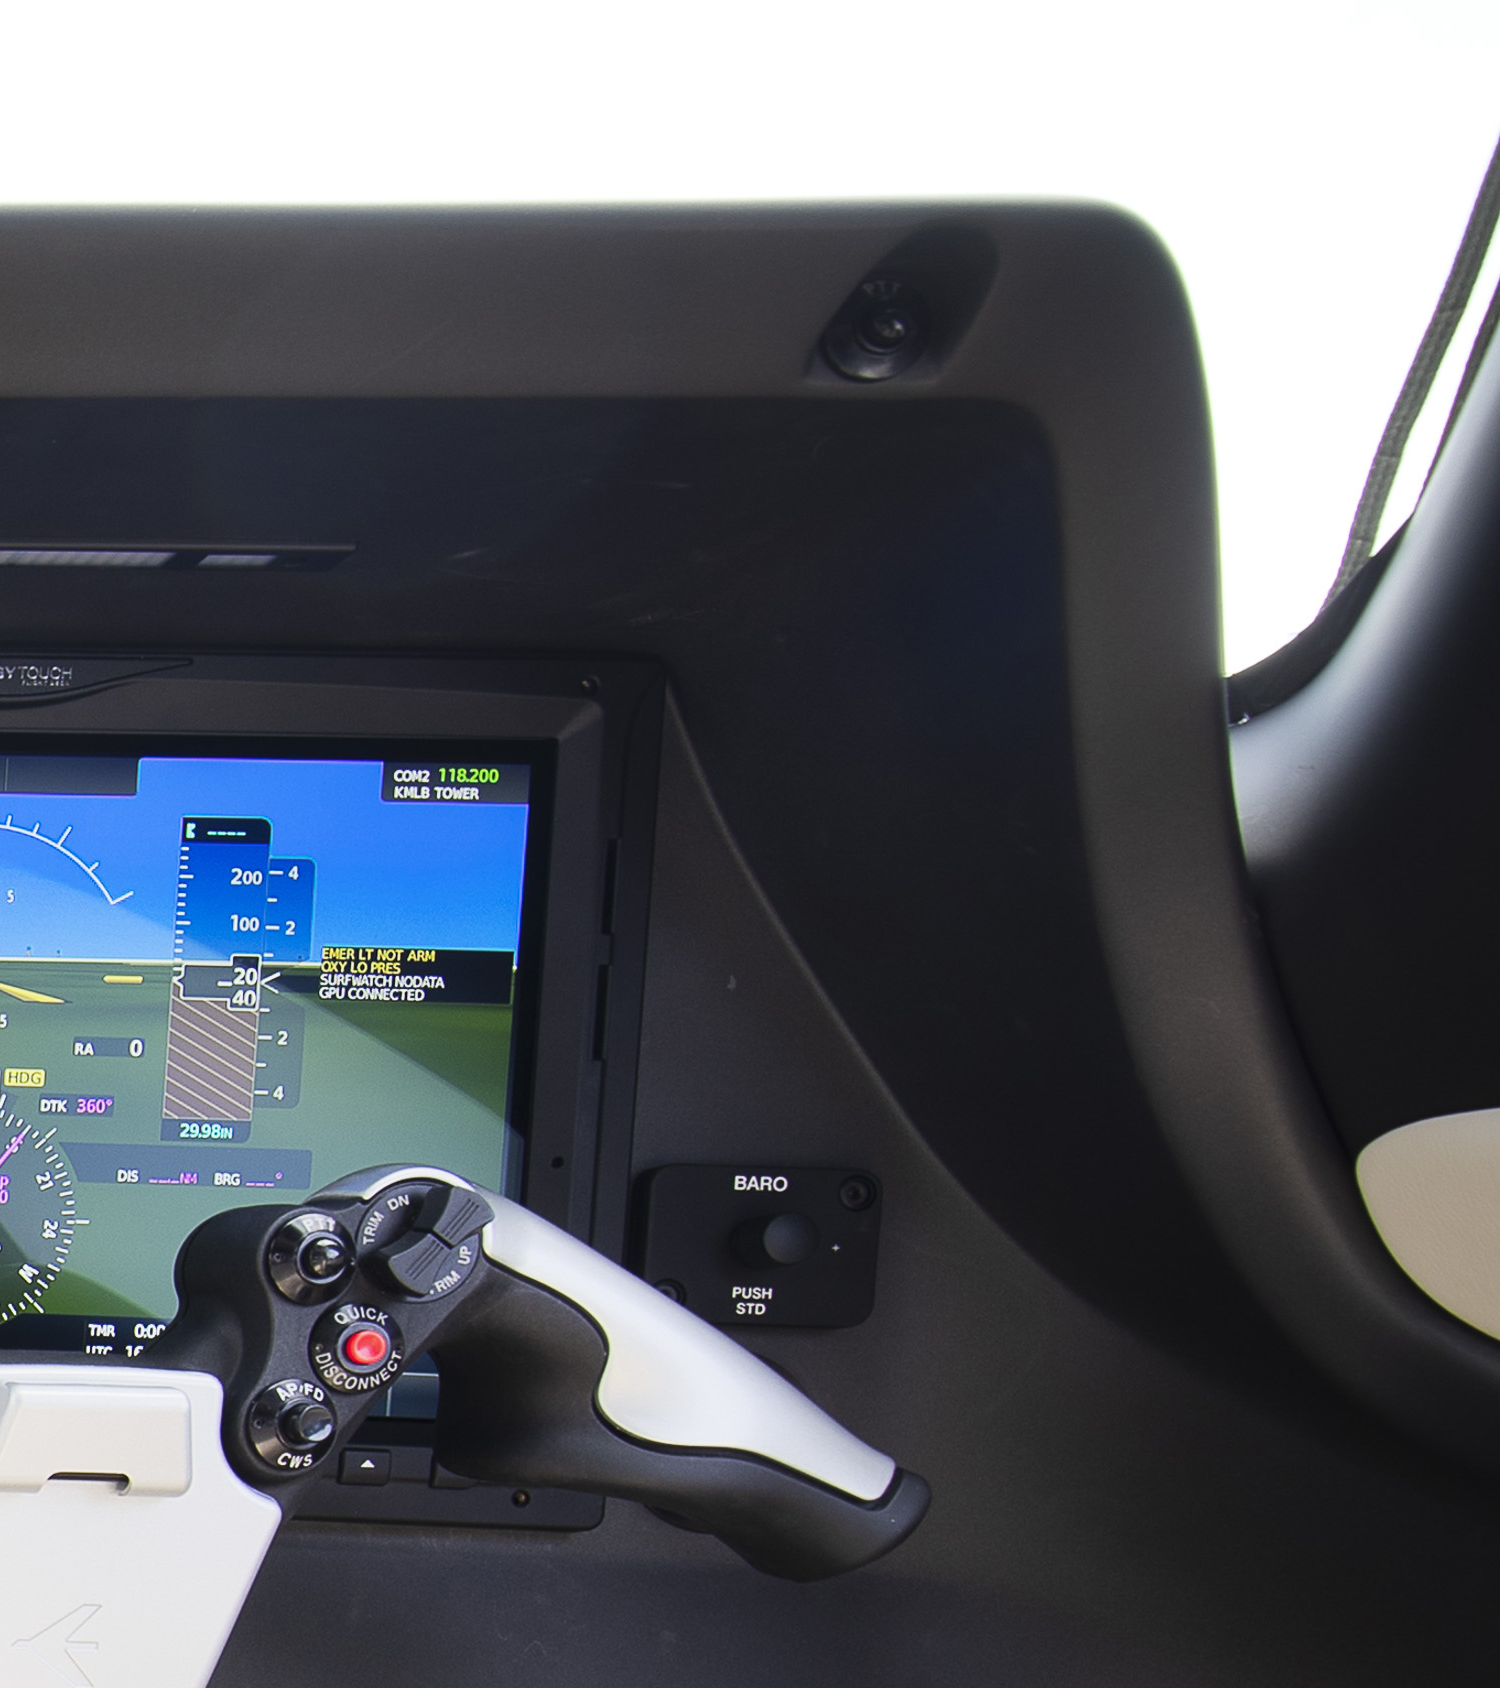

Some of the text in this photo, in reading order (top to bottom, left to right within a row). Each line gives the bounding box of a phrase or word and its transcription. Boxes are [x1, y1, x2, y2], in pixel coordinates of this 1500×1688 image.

[393, 767, 499, 783] COM2 118.200
[394, 786, 479, 800] KMLB TOWER
[322, 949, 435, 963] EMER LT NOT ARM
[321, 962, 401, 975] OXY LO PRES
[320, 975, 444, 990] SURFWATCH NODATA
[319, 988, 425, 1002] GPU CONNECTED
[734, 1174, 789, 1193] BARO
[732, 1287, 773, 1300] PUSH
[735, 1302, 766, 1316] STD
[334, 1308, 389, 1326] QUICK
[315, 1350, 403, 1391] DISCONNECT
[277, 1451, 313, 1469] CWS
